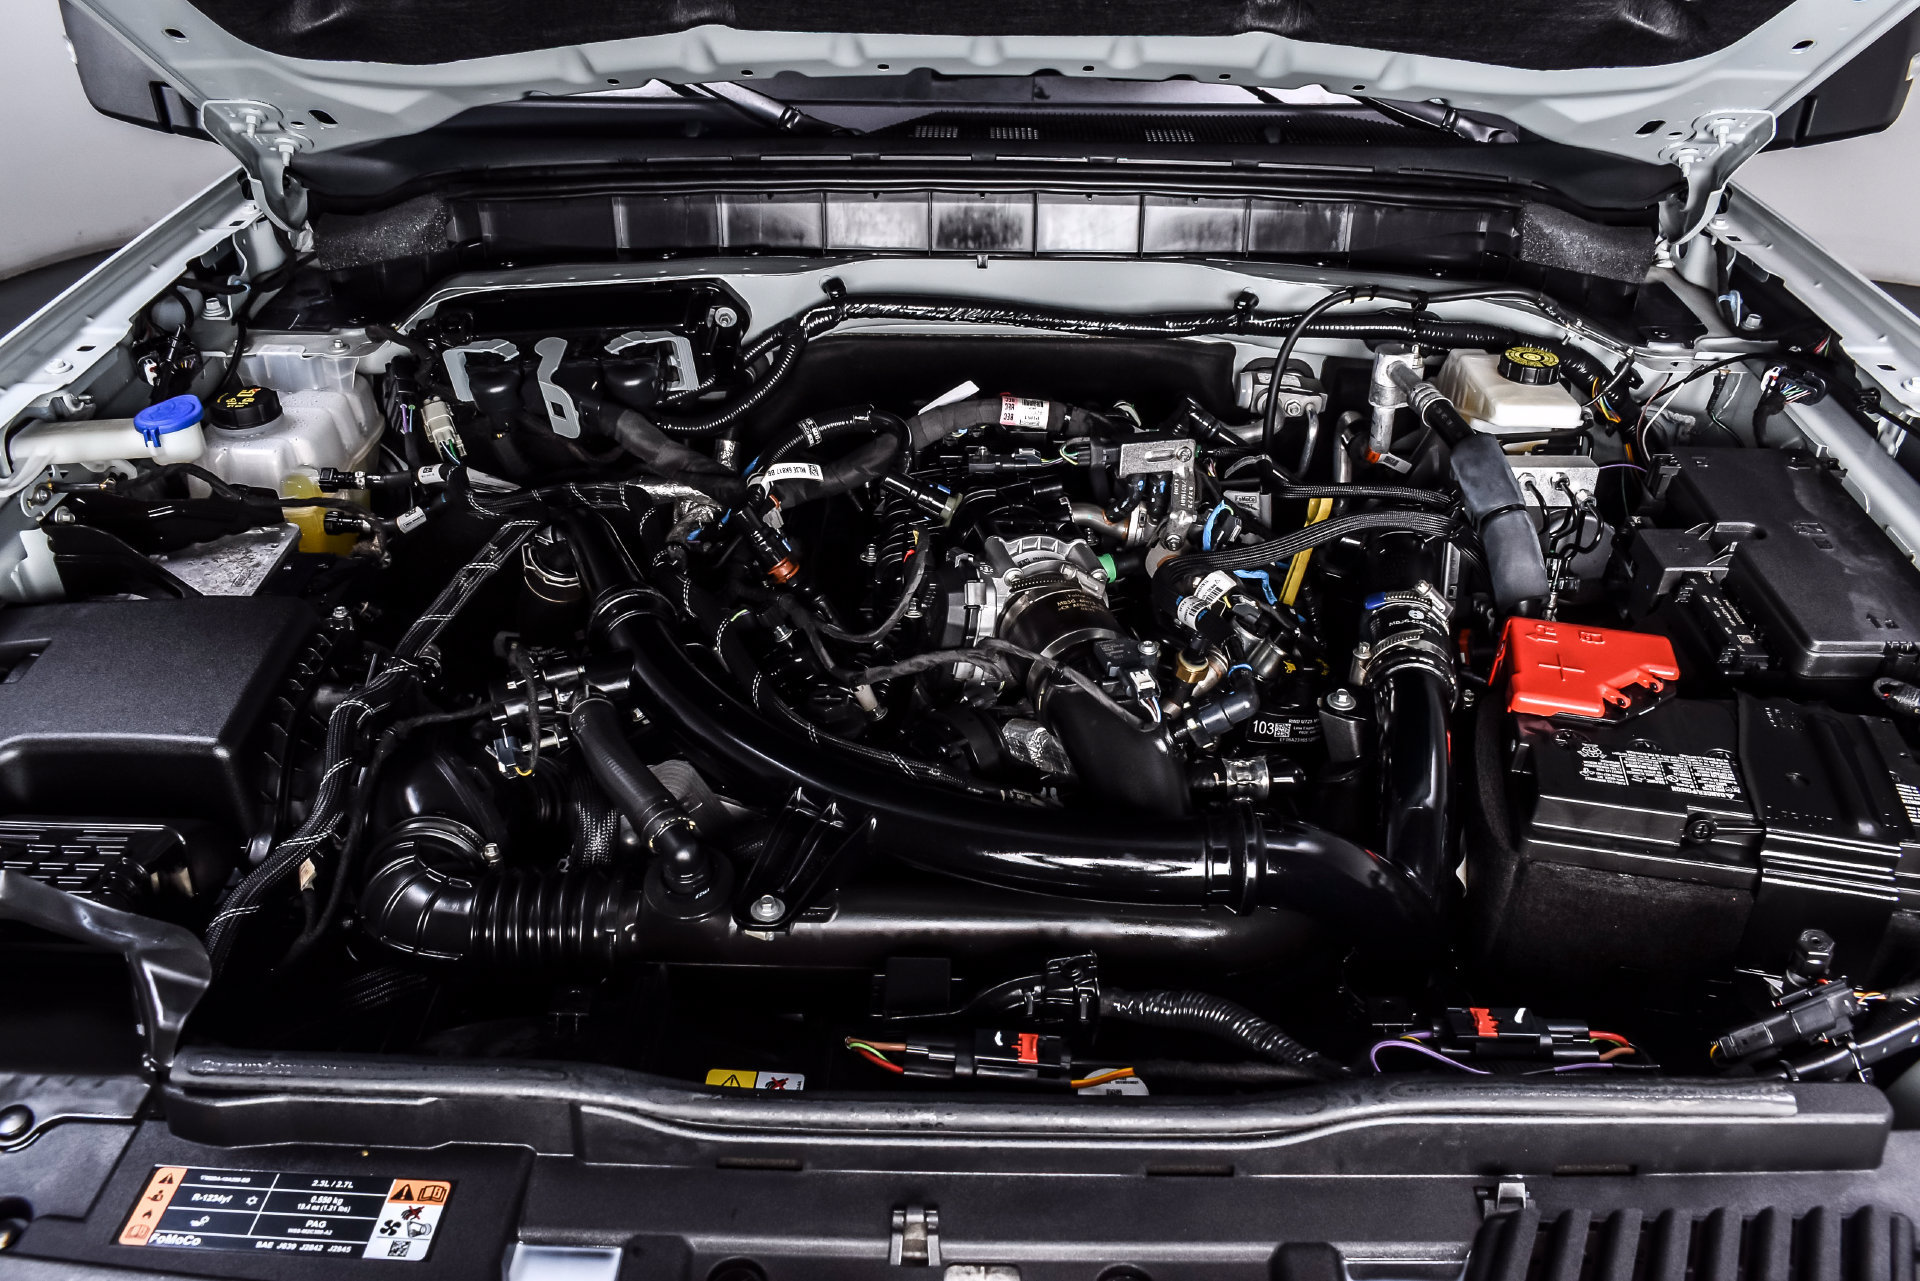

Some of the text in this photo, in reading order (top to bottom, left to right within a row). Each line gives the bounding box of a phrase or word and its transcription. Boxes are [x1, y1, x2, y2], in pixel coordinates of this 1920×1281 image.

[1253, 719, 1275, 735] 103
[311, 1179, 330, 1188] 2.3L
[335, 1180, 354, 1189] 2.7L
[191, 1192, 233, 1205] R-1234yf
[332, 1196, 344, 1206] kg
[305, 1219, 327, 1229] PAG
[148, 1232, 202, 1246] FoMoCo
[255, 1240, 274, 1249] SAE
